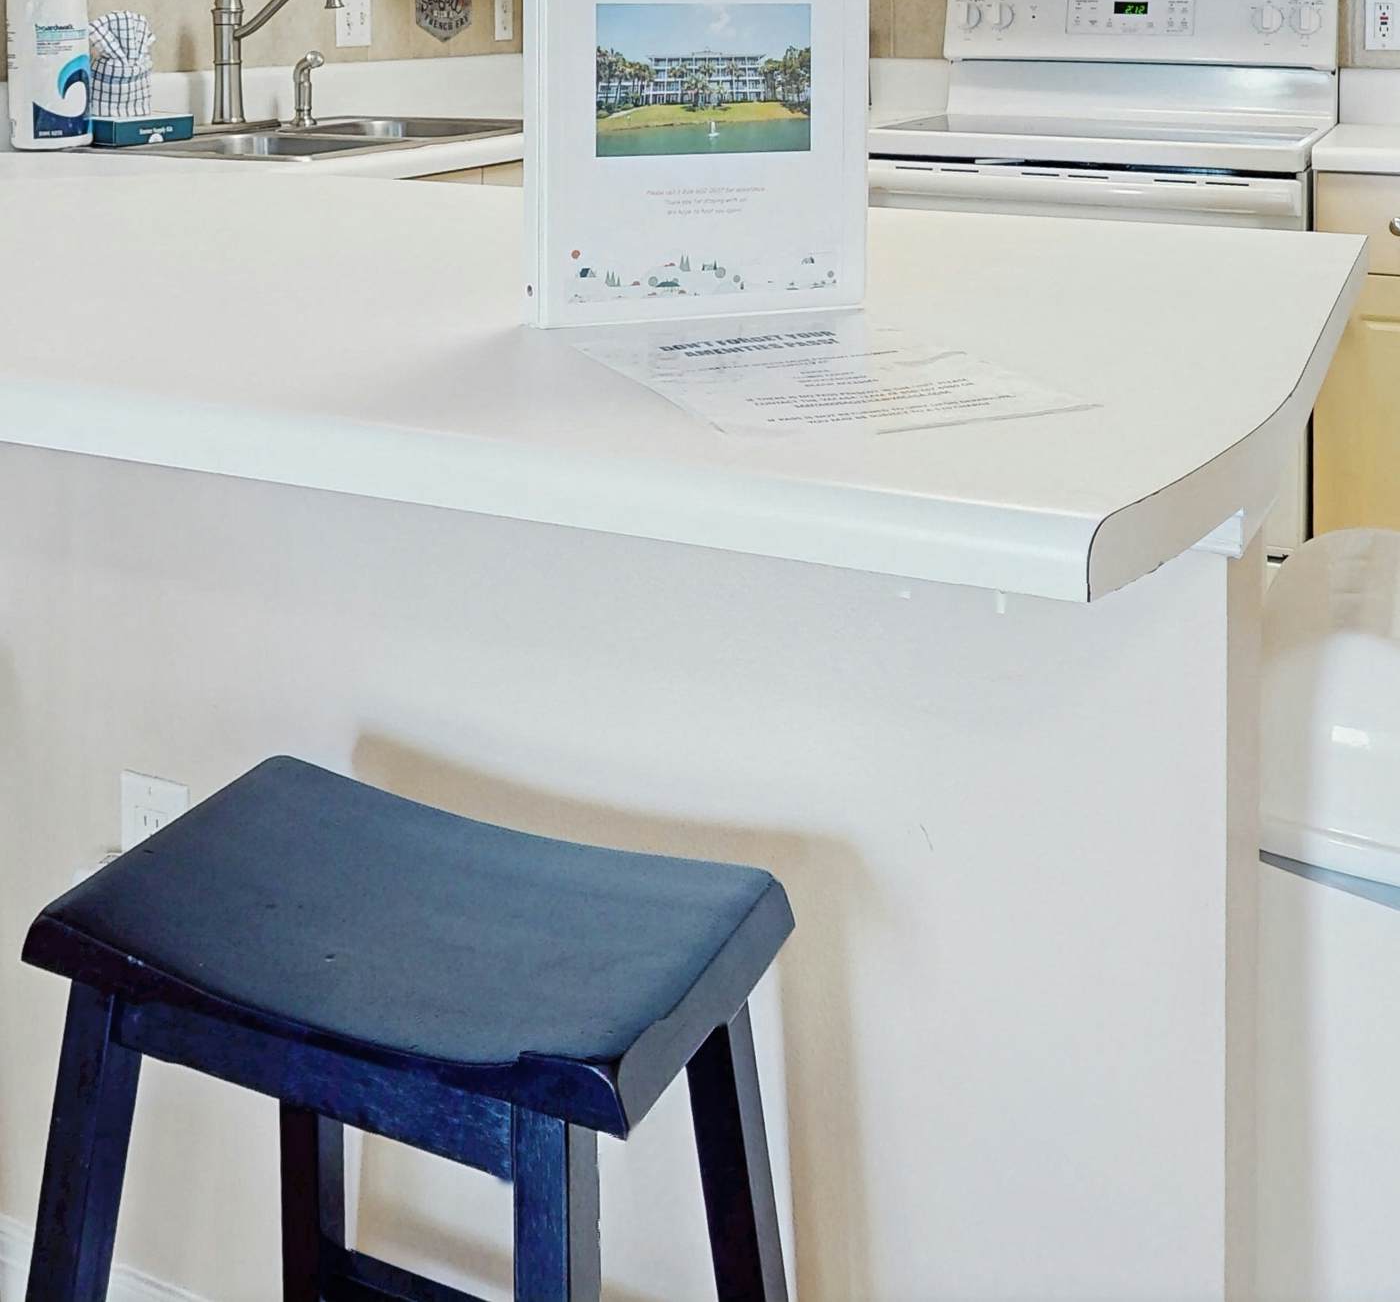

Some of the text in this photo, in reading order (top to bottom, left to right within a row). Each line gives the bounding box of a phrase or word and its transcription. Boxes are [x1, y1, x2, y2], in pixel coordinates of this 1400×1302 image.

[715, 334, 784, 347] FORGET
[784, 330, 837, 341] YOUR
[684, 343, 784, 358] AMENITIES
